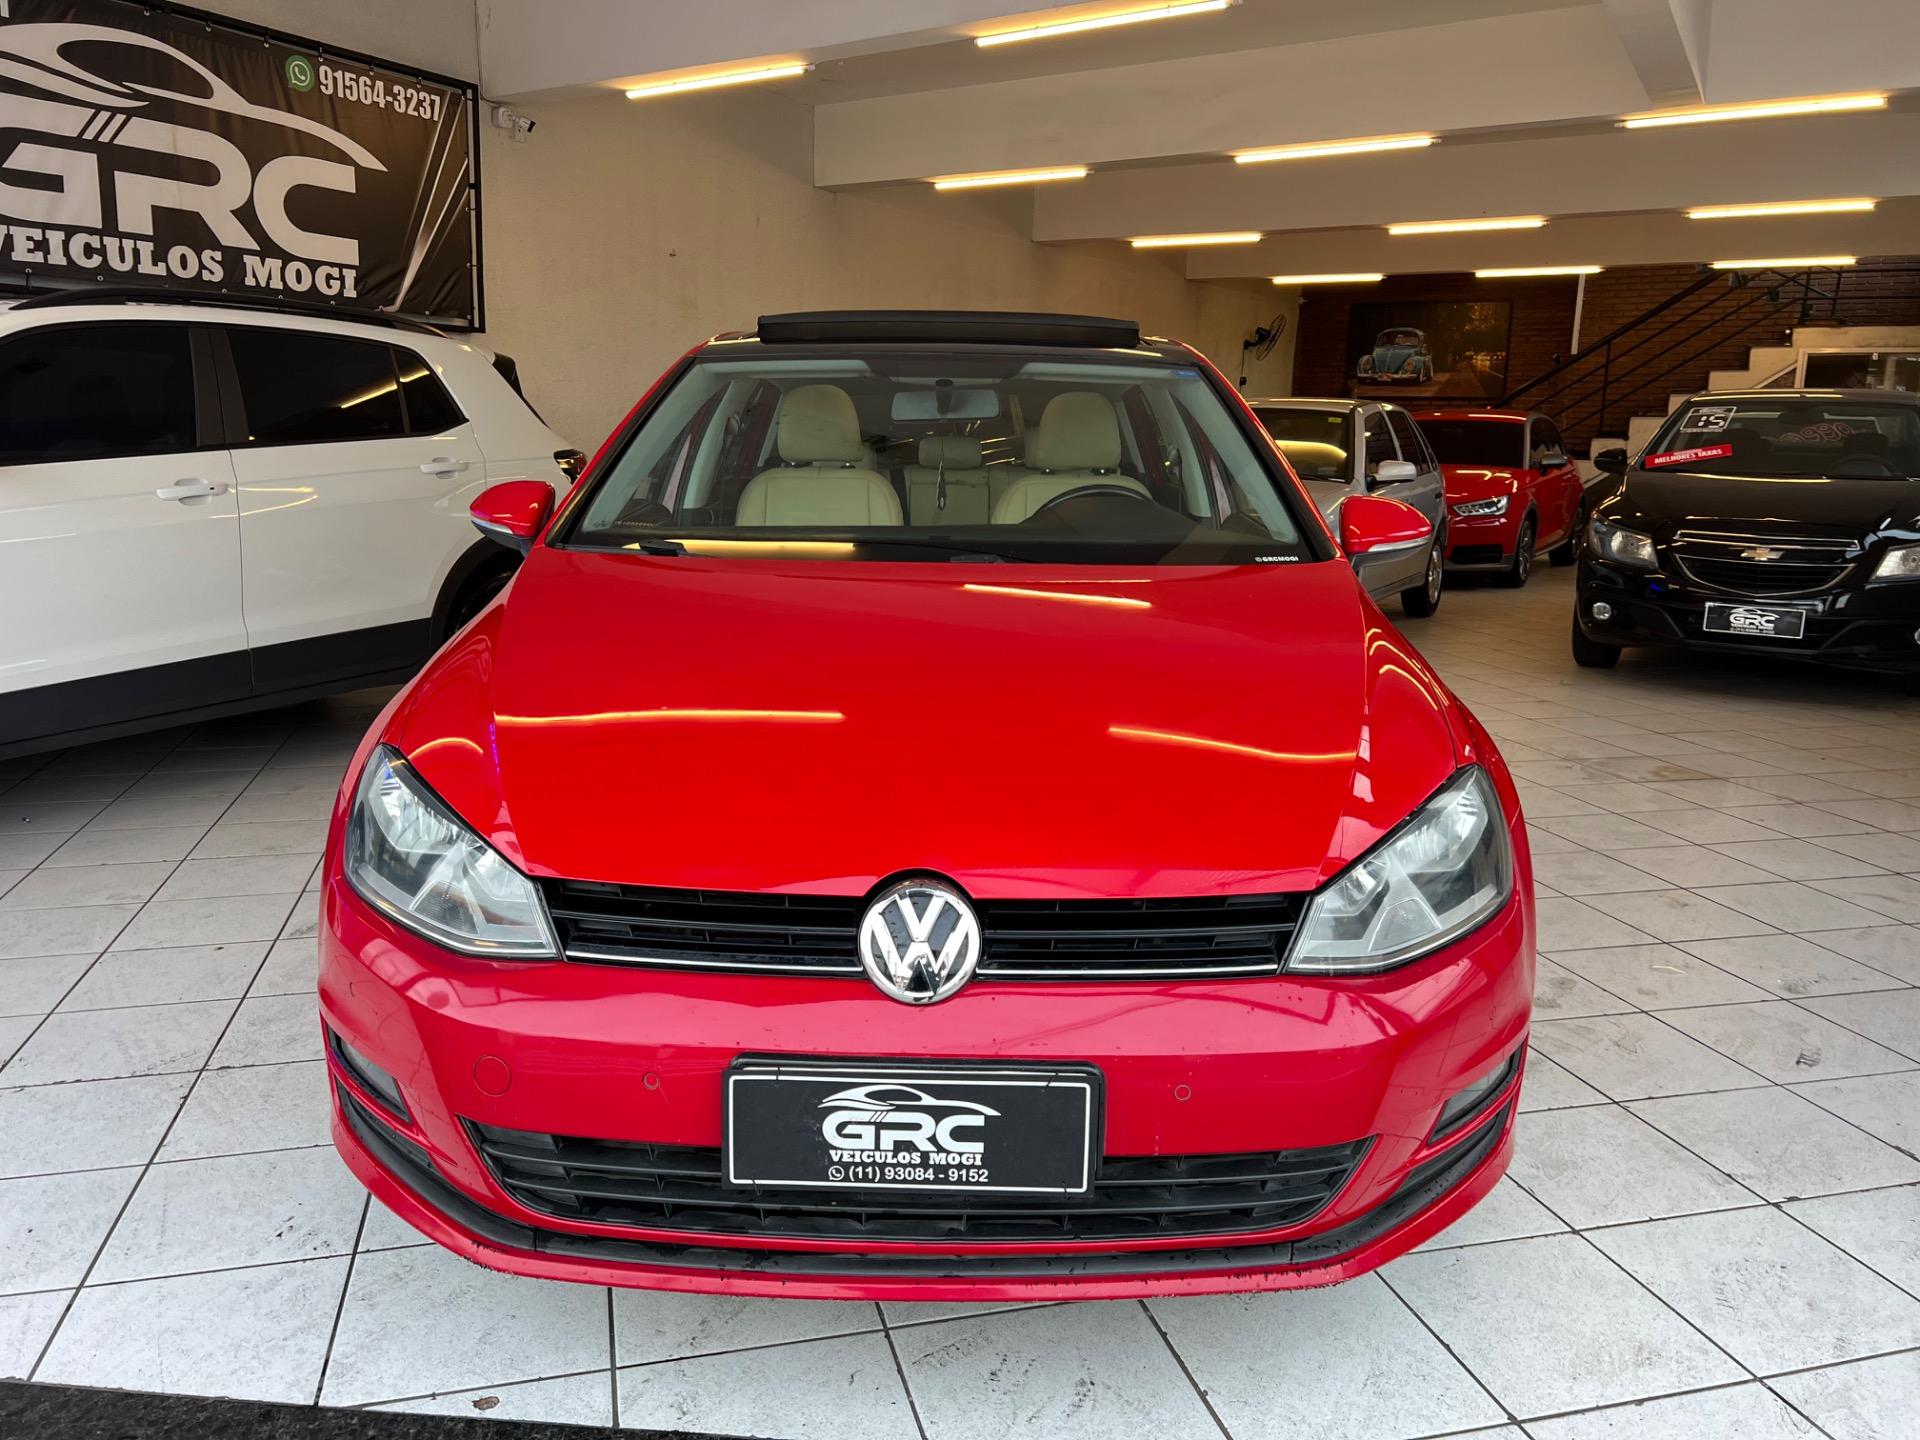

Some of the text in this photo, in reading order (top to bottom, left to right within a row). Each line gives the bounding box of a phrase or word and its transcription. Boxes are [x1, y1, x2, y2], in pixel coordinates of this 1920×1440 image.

[318, 65, 441, 121] 91564-3237
[0, 91, 360, 266] GRC
[0, 224, 358, 298] EICULOS MOGI
[1654, 451, 1697, 464] MELHORES
[1729, 613, 1776, 627] GRC
[822, 1110, 985, 1153] GRC
[829, 1150, 982, 1166] VEICULOS MOGI
[849, 1165, 880, 1182] (11)
[885, 1167, 935, 1181] 93084
[948, 1169, 989, 1182] 9152
